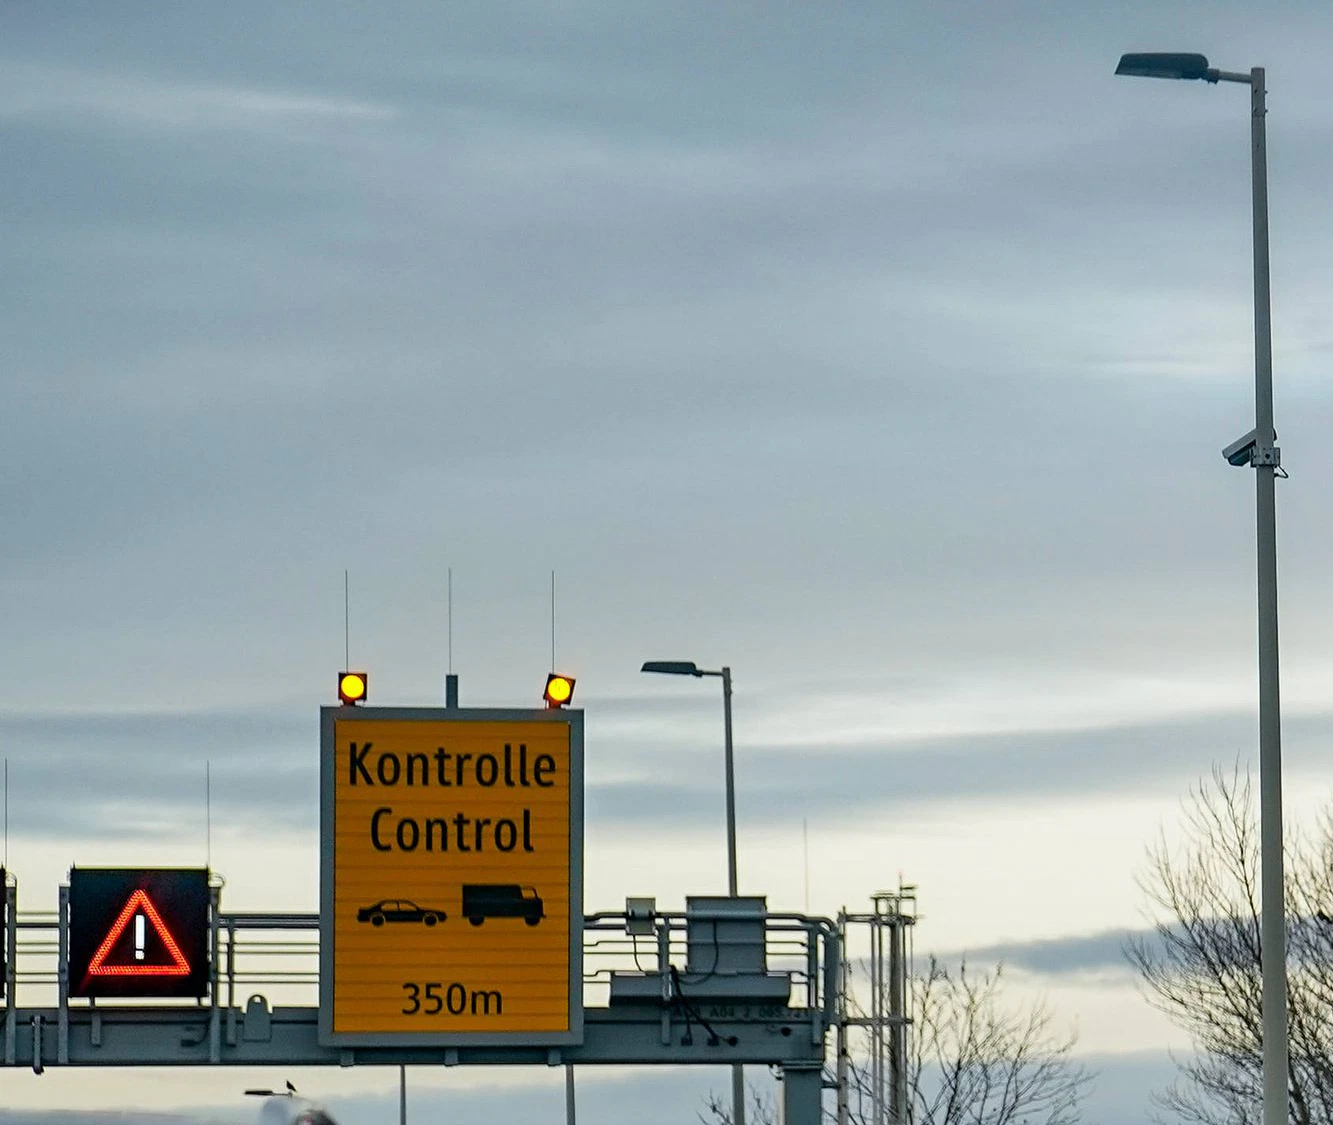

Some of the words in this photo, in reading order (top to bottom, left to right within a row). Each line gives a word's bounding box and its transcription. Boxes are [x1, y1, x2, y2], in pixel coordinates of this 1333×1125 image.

[350, 742, 556, 787] Kontrolle
[371, 808, 534, 852] Control
[402, 982, 502, 1015] 350m
